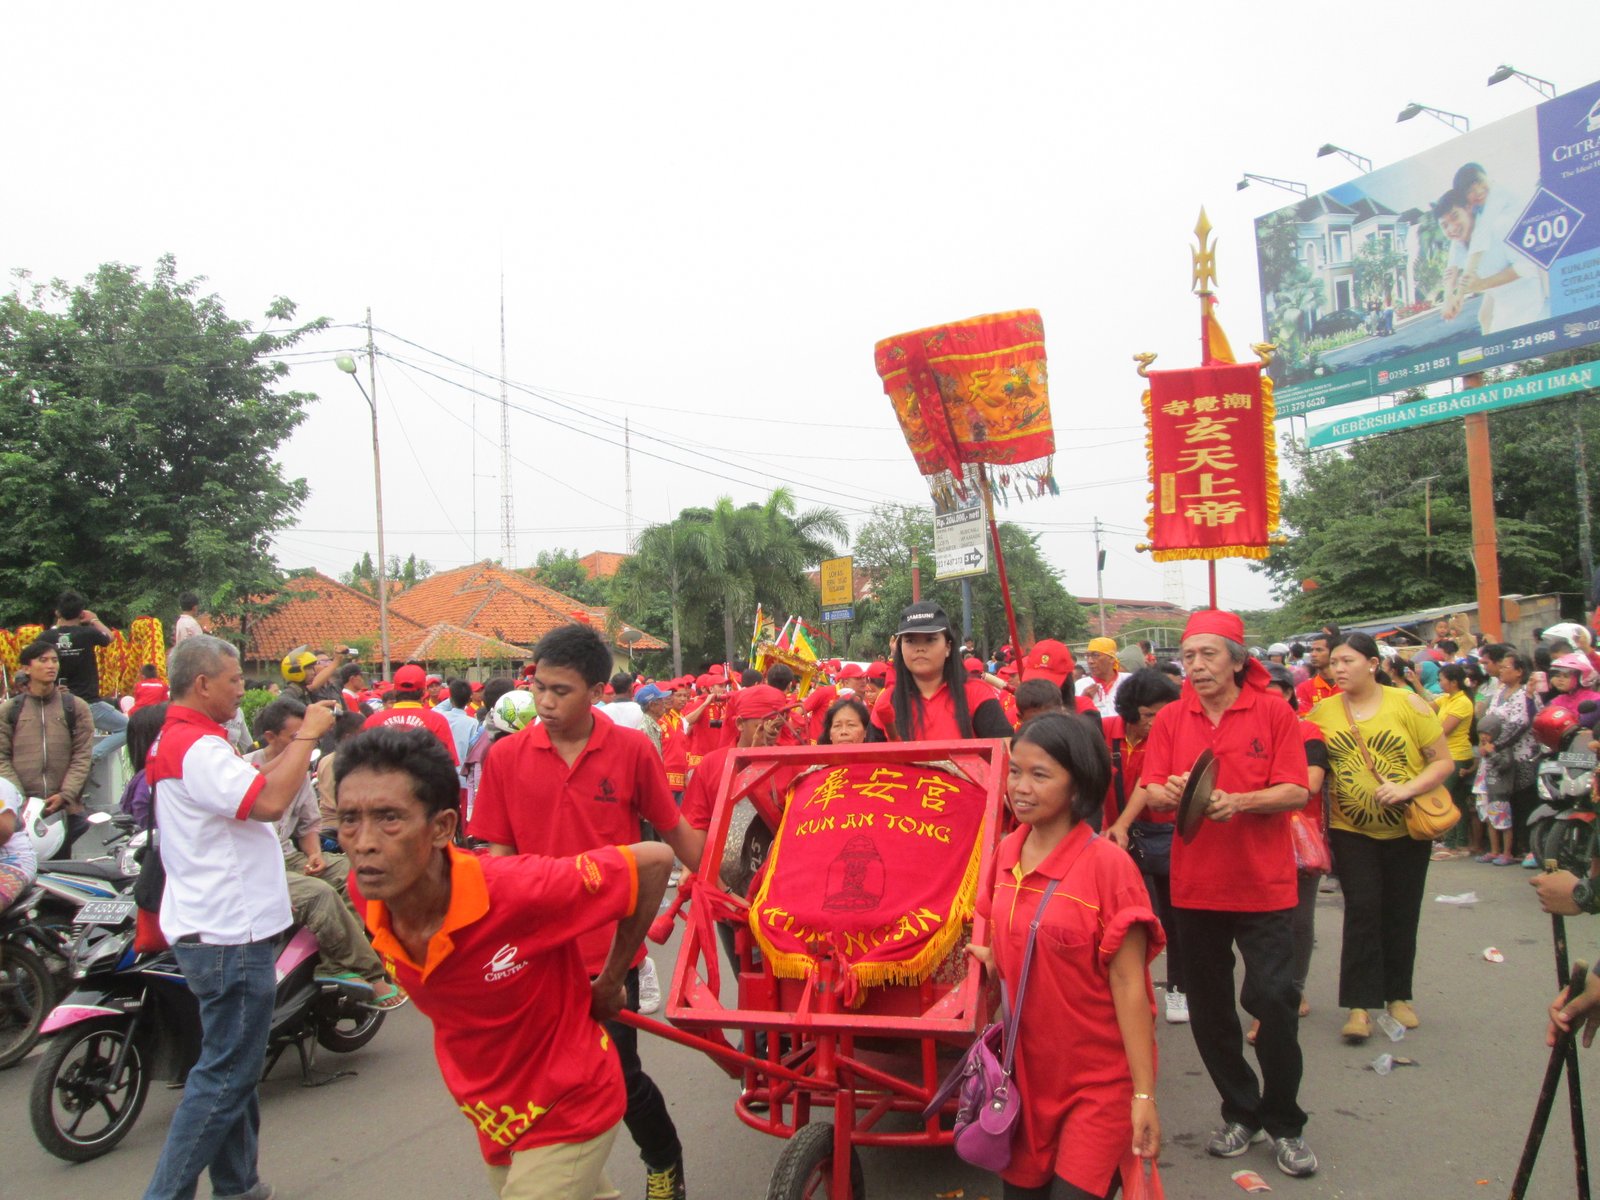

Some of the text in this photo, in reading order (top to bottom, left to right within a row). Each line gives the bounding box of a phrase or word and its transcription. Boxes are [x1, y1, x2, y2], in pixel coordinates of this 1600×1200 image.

[1522, 215, 1569, 248] 600
[1483, 344, 1504, 356] 0231
[1512, 335, 1533, 350] 234
[1534, 330, 1556, 344] 998
[1413, 362, 1431, 374] 321
[1332, 369, 1592, 436] KEBERSIHAN SEBAGIAN DARI IMAN
[907, 613, 934, 622] SAMSUNG
[795, 813, 951, 843] KUN AN TONG
[484, 961, 529, 982] CIPUTRA
